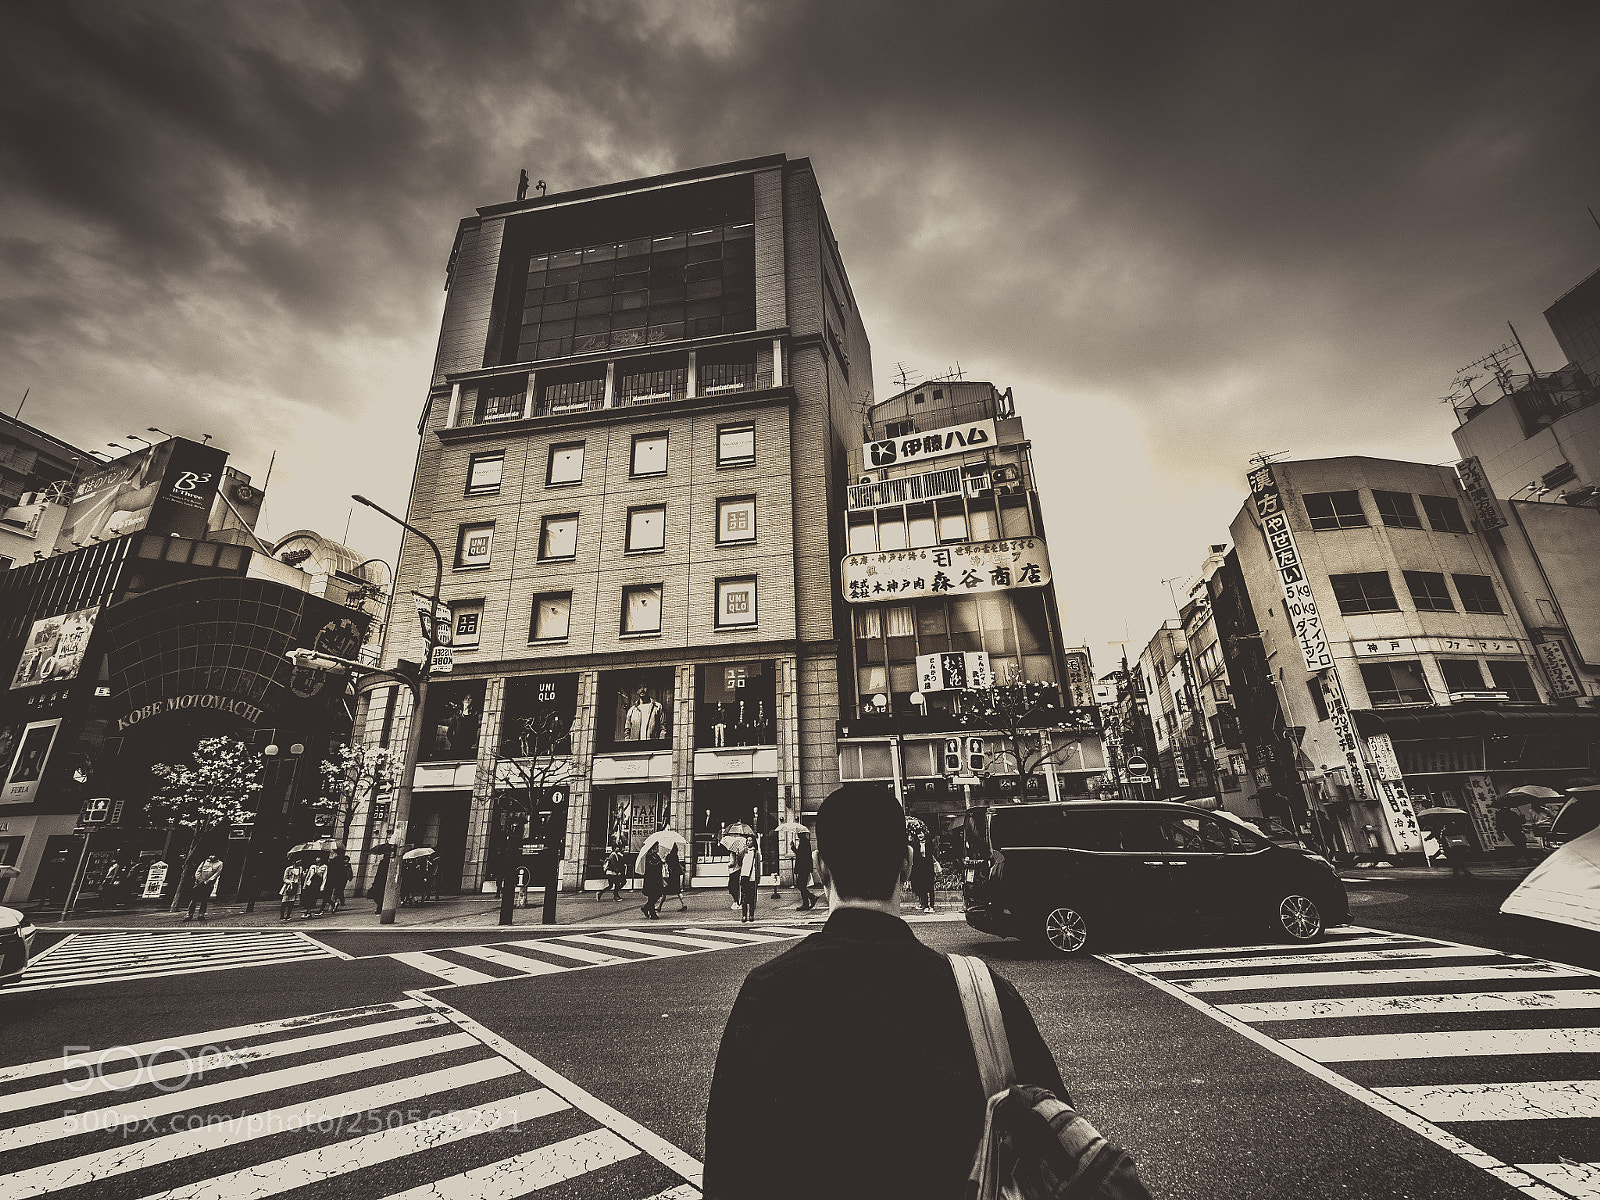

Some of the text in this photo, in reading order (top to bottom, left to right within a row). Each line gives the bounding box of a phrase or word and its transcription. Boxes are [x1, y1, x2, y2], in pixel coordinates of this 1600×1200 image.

[901, 428, 988, 457] 伊藤ハム
[1250, 468, 1304, 583] 漢方 やせたい
[470, 547, 486, 555] QLO
[931, 563, 1041, 593] 森谷商店
[729, 593, 747, 601] UNI
[728, 603, 747, 612] QLO
[1296, 617, 1318, 669] ダイエット
[1307, 617, 1331, 666] マイクロ
[1367, 641, 1514, 654] 神戸 ファーマシー
[539, 683, 555, 692] UNI
[538, 692, 556, 701] QLO
[117, 694, 264, 731] KOBE MOTOMACHI
[633, 805, 655, 816] TAX
[633, 816, 655, 824] FREE
